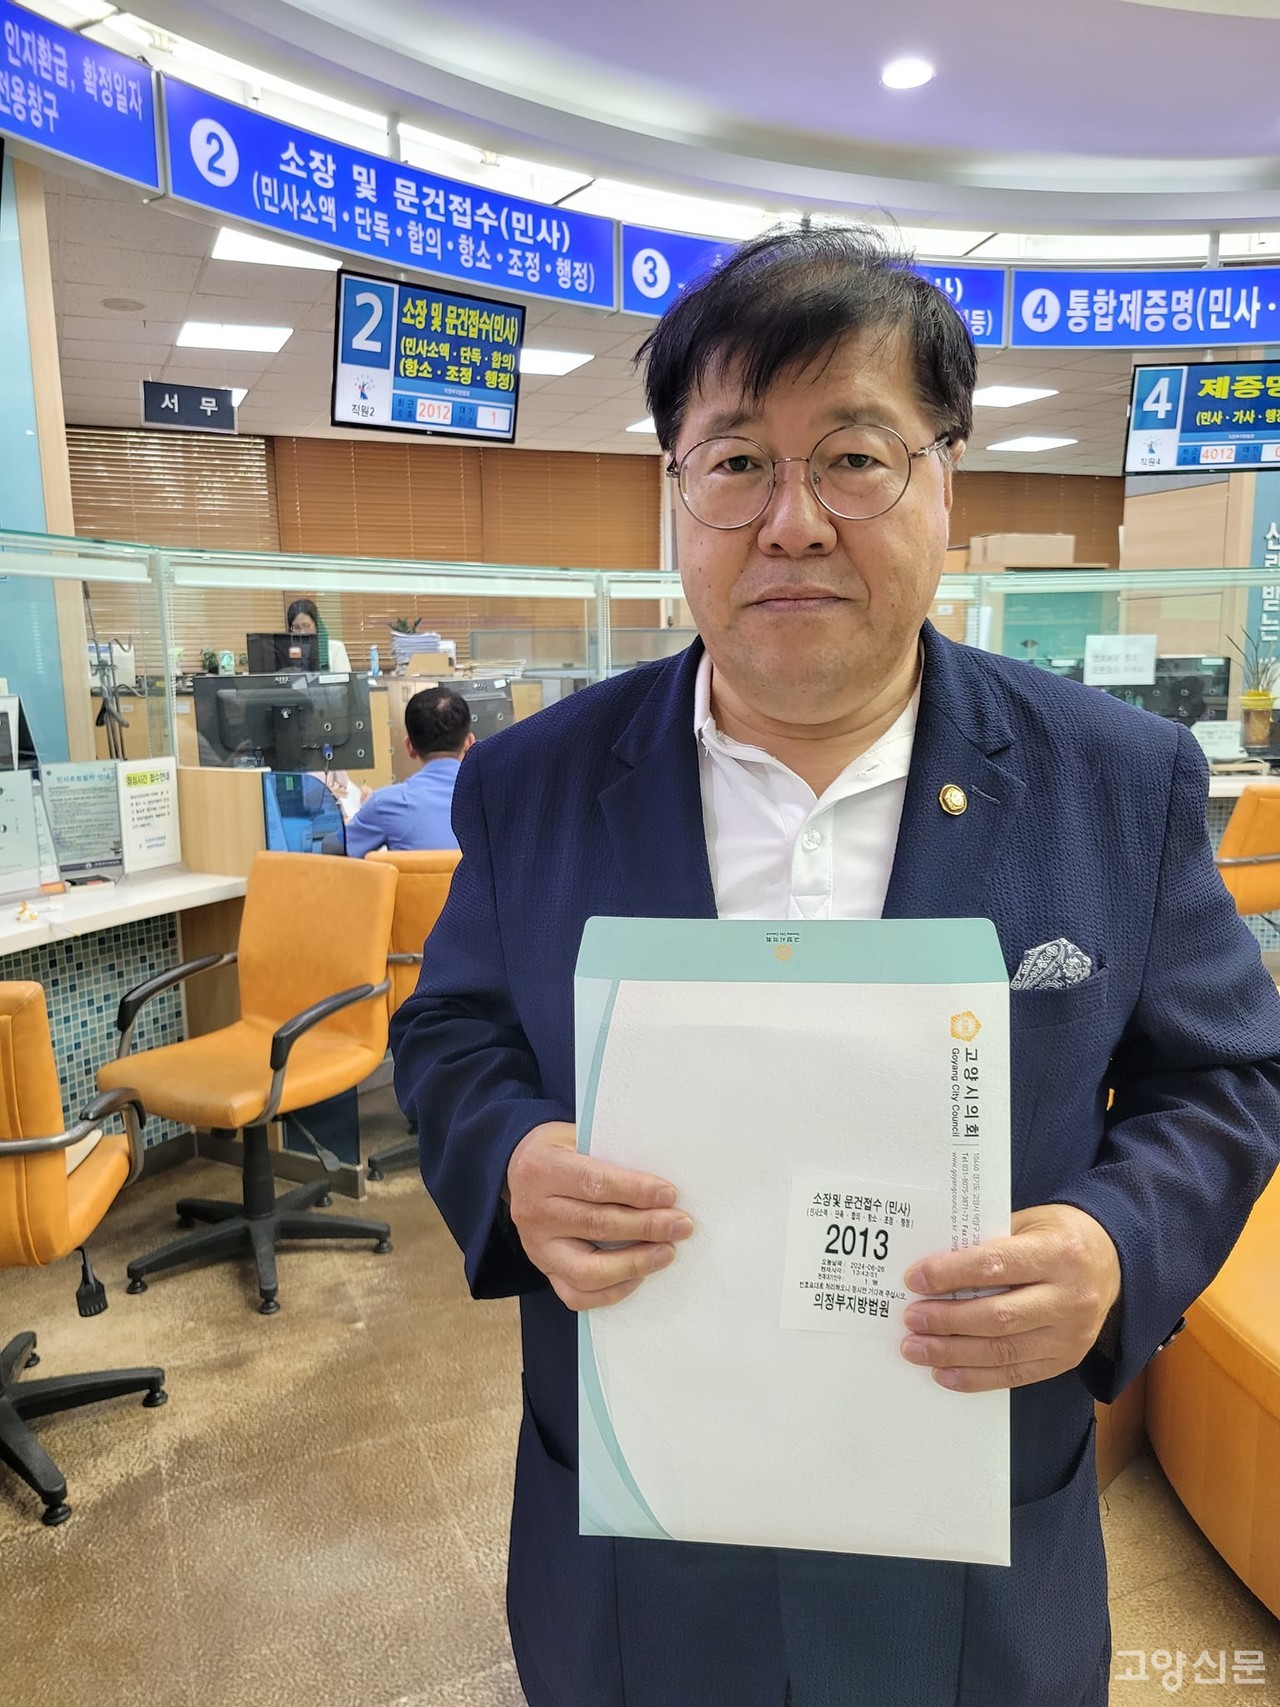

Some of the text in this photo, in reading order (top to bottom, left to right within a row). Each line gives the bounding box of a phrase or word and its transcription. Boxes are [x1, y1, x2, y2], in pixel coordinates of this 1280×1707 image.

[4, 20, 143, 121] 인지환급, 확정일자
[206, 131, 226, 177] 2
[279, 141, 571, 253] 소장 및 문건접수(민사)
[643, 255, 658, 288] 3
[351, 291, 383, 353] 2
[401, 297, 519, 347] 소장 및 문건접수(민사)
[1032, 295, 1048, 323] 4
[351, 404, 376, 418] 직원2
[418, 402, 451, 421] 2012
[1142, 377, 1173, 419] 4
[491, 411, 496, 425] 1
[1201, 447, 1234, 461] 4012
[950, 1047, 961, 1137] Goyang City Council
[963, 1047, 980, 1138] 고양시의회
[961, 1152, 969, 1162] Tel
[844, 1195, 883, 1212] 문건접수
[885, 1200, 911, 1217] (민사)
[824, 1223, 889, 1261] 2013
[961, 1225, 969, 1237] Fax
[850, 1261, 885, 1273] 2024-06-26
[813, 1292, 890, 1318] 의정부지방법원
